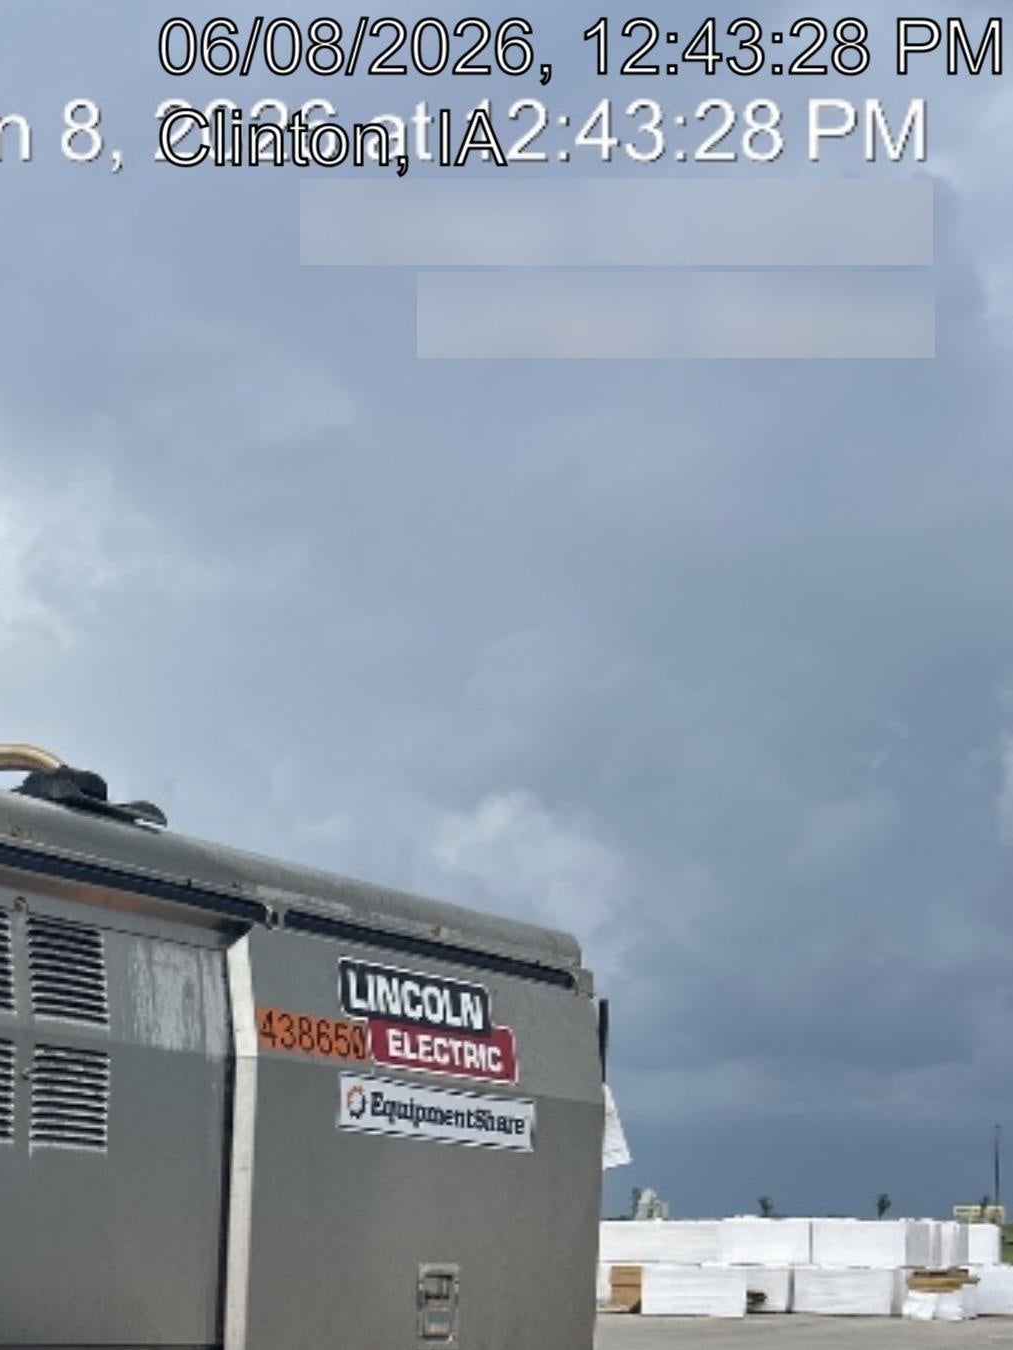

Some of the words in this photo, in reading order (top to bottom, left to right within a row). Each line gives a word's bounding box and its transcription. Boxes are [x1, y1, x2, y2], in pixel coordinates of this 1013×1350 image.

[348, 972, 483, 1030] LINCOLN
[260, 1010, 367, 1061] 438650
[387, 1030, 502, 1072] ELECTRIC
[370, 1091, 525, 1135] EquipmentShare
